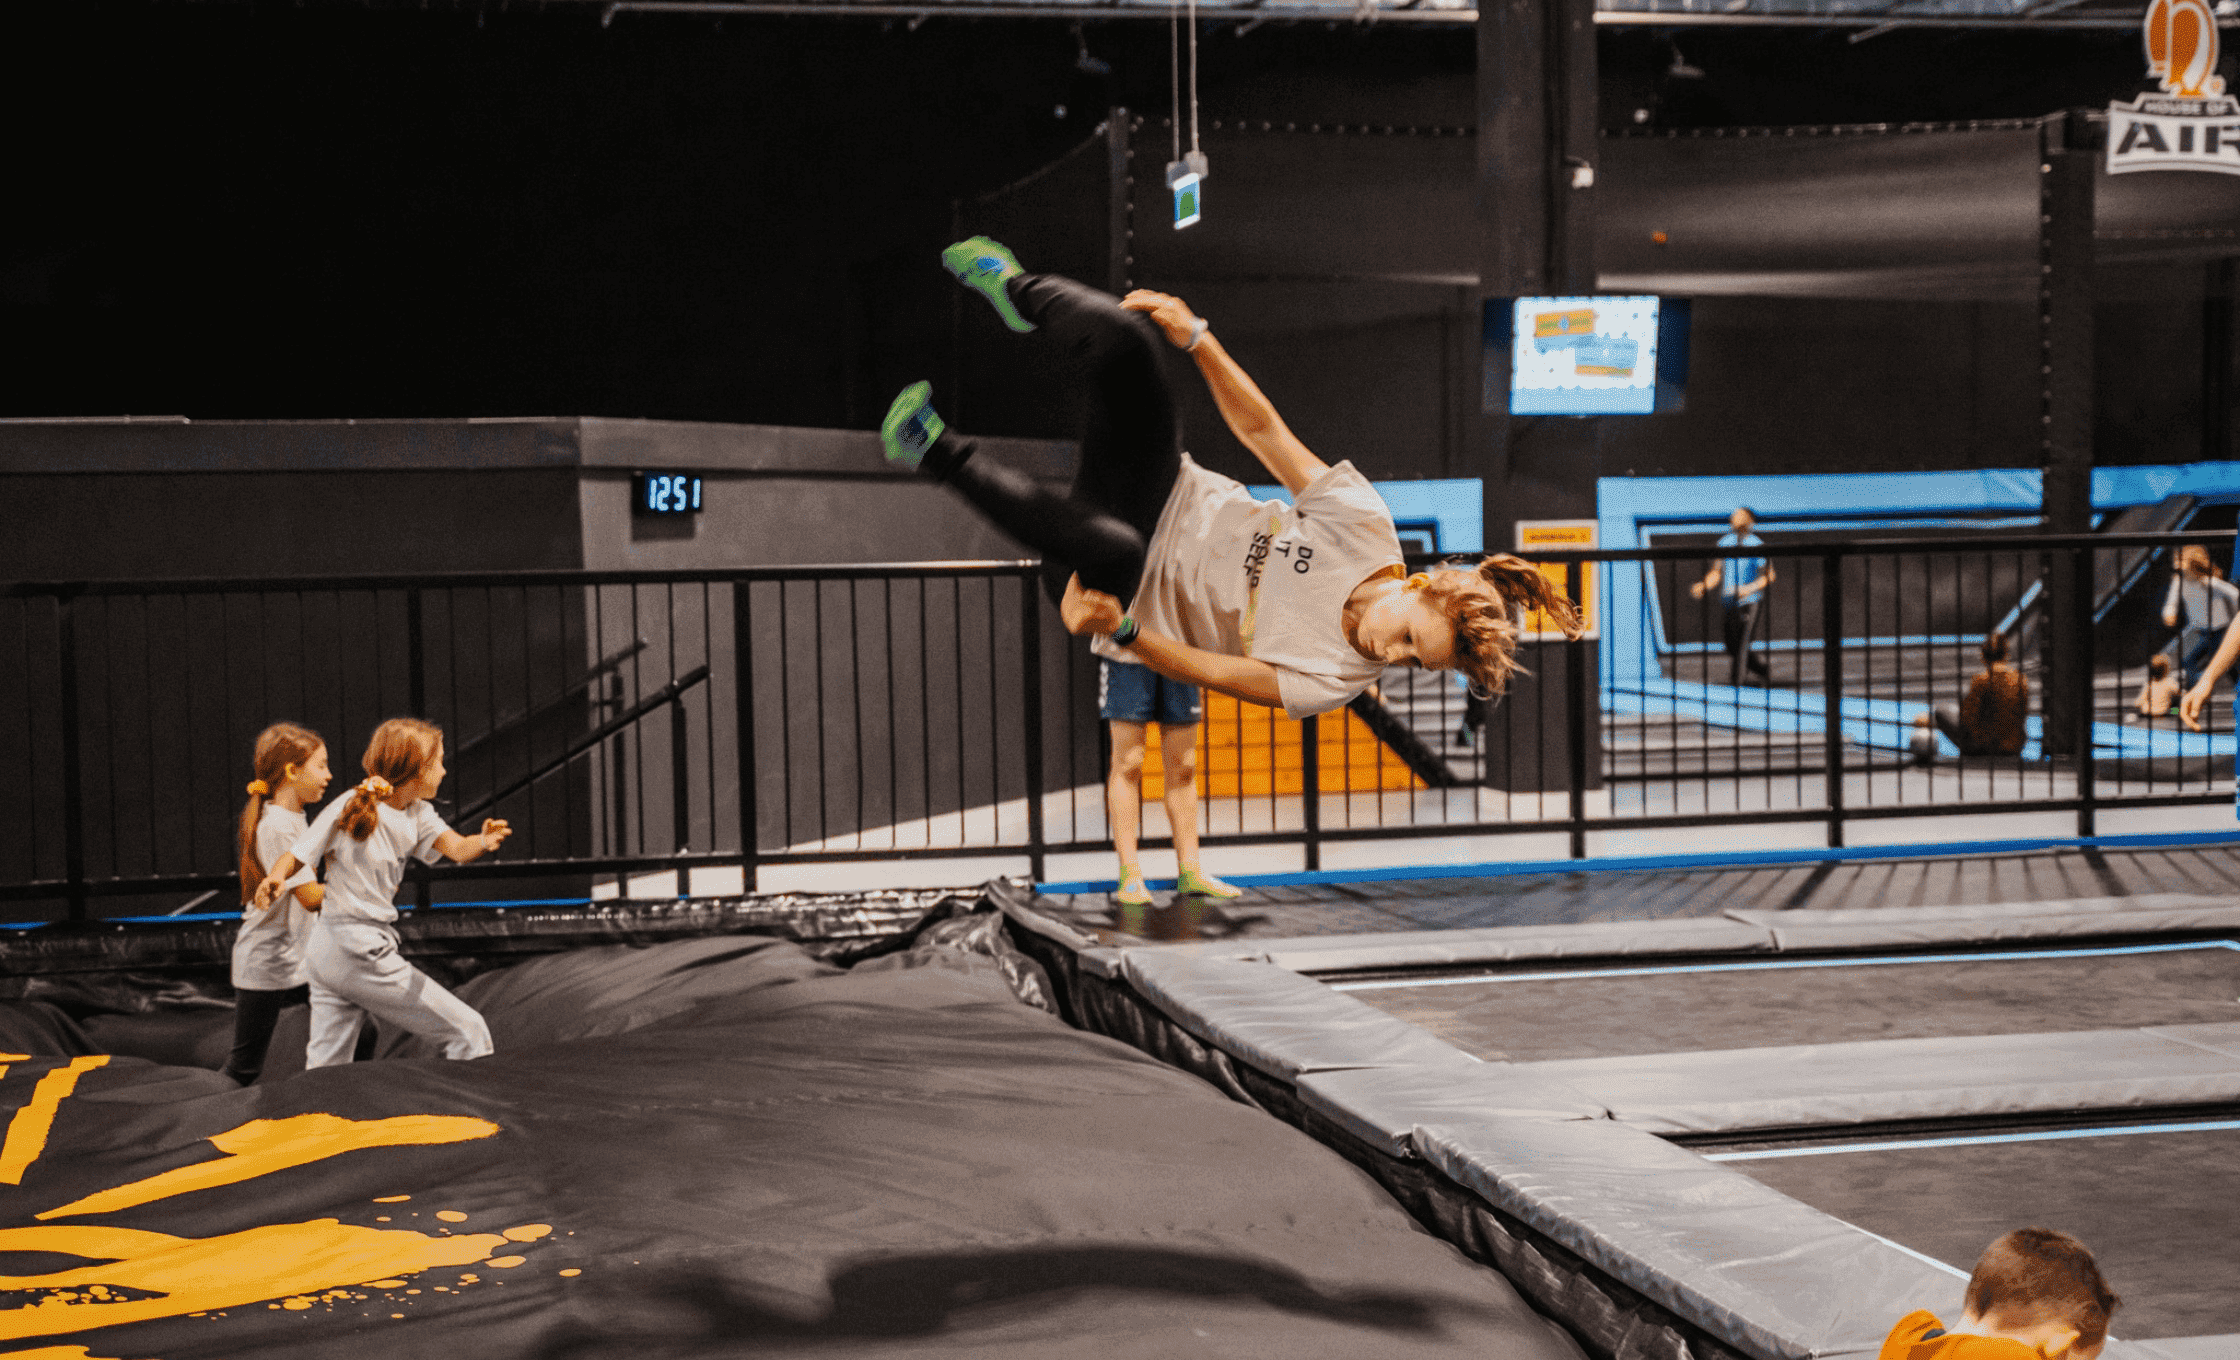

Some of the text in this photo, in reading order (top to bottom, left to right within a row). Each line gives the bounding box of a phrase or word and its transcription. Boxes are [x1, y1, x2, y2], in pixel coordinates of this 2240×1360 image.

[2116, 121, 2240, 155] AIR
[1274, 540, 1292, 557] IT
[1293, 546, 1313, 574] DO
